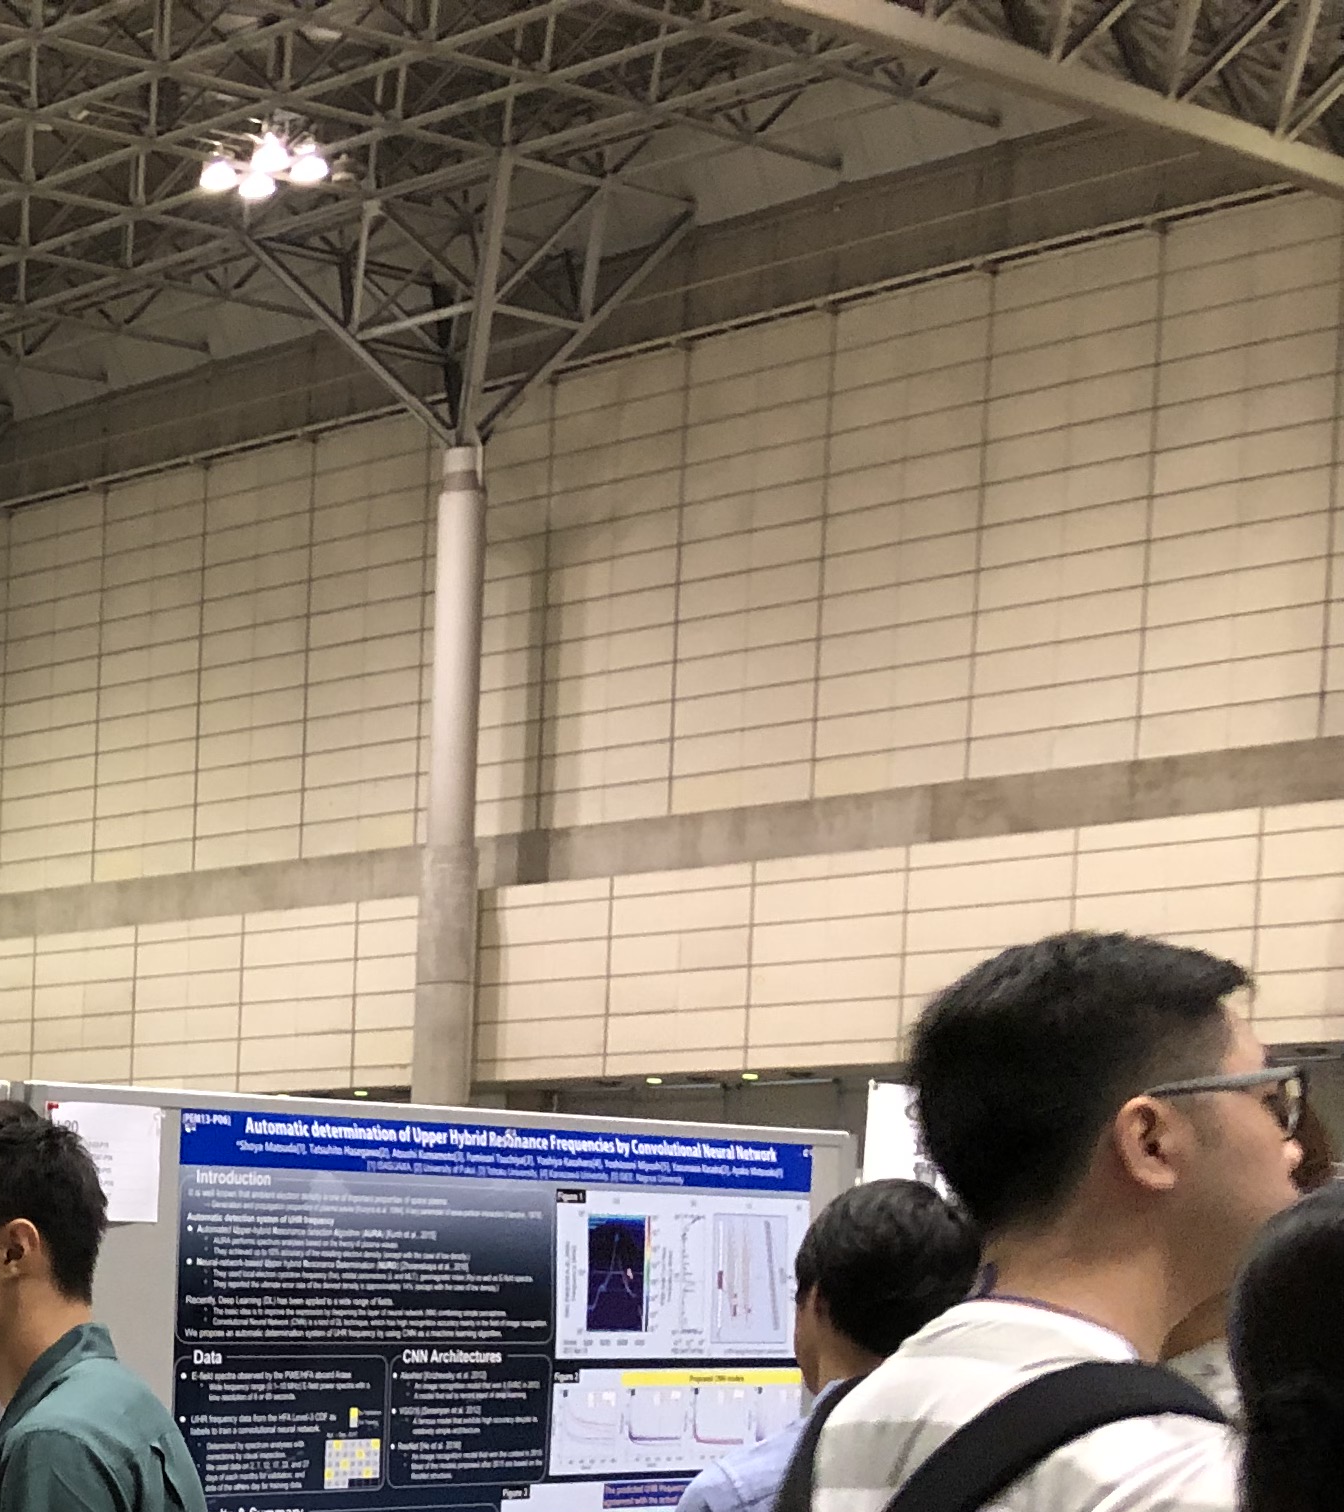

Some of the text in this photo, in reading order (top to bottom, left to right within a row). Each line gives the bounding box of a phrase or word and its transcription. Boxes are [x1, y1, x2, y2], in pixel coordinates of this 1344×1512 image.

[246, 1118, 309, 1137] Automatic
[312, 1120, 396, 1141] determination
[399, 1125, 412, 1142] of
[413, 1126, 447, 1147] Upper
[449, 1129, 487, 1149] Hybrid
[550, 1134, 614, 1154] Frequencies
[617, 1137, 630, 1156] by
[632, 1139, 701, 1160] Convolutional
[703, 1145, 735, 1161] Neural
[738, 1146, 777, 1162] Network
[197, 1170, 271, 1186] Introduction
[193, 1350, 221, 1365] Data
[403, 1349, 502, 1364] CNN Architectures
[502, 1488, 520, 1499] Figure
